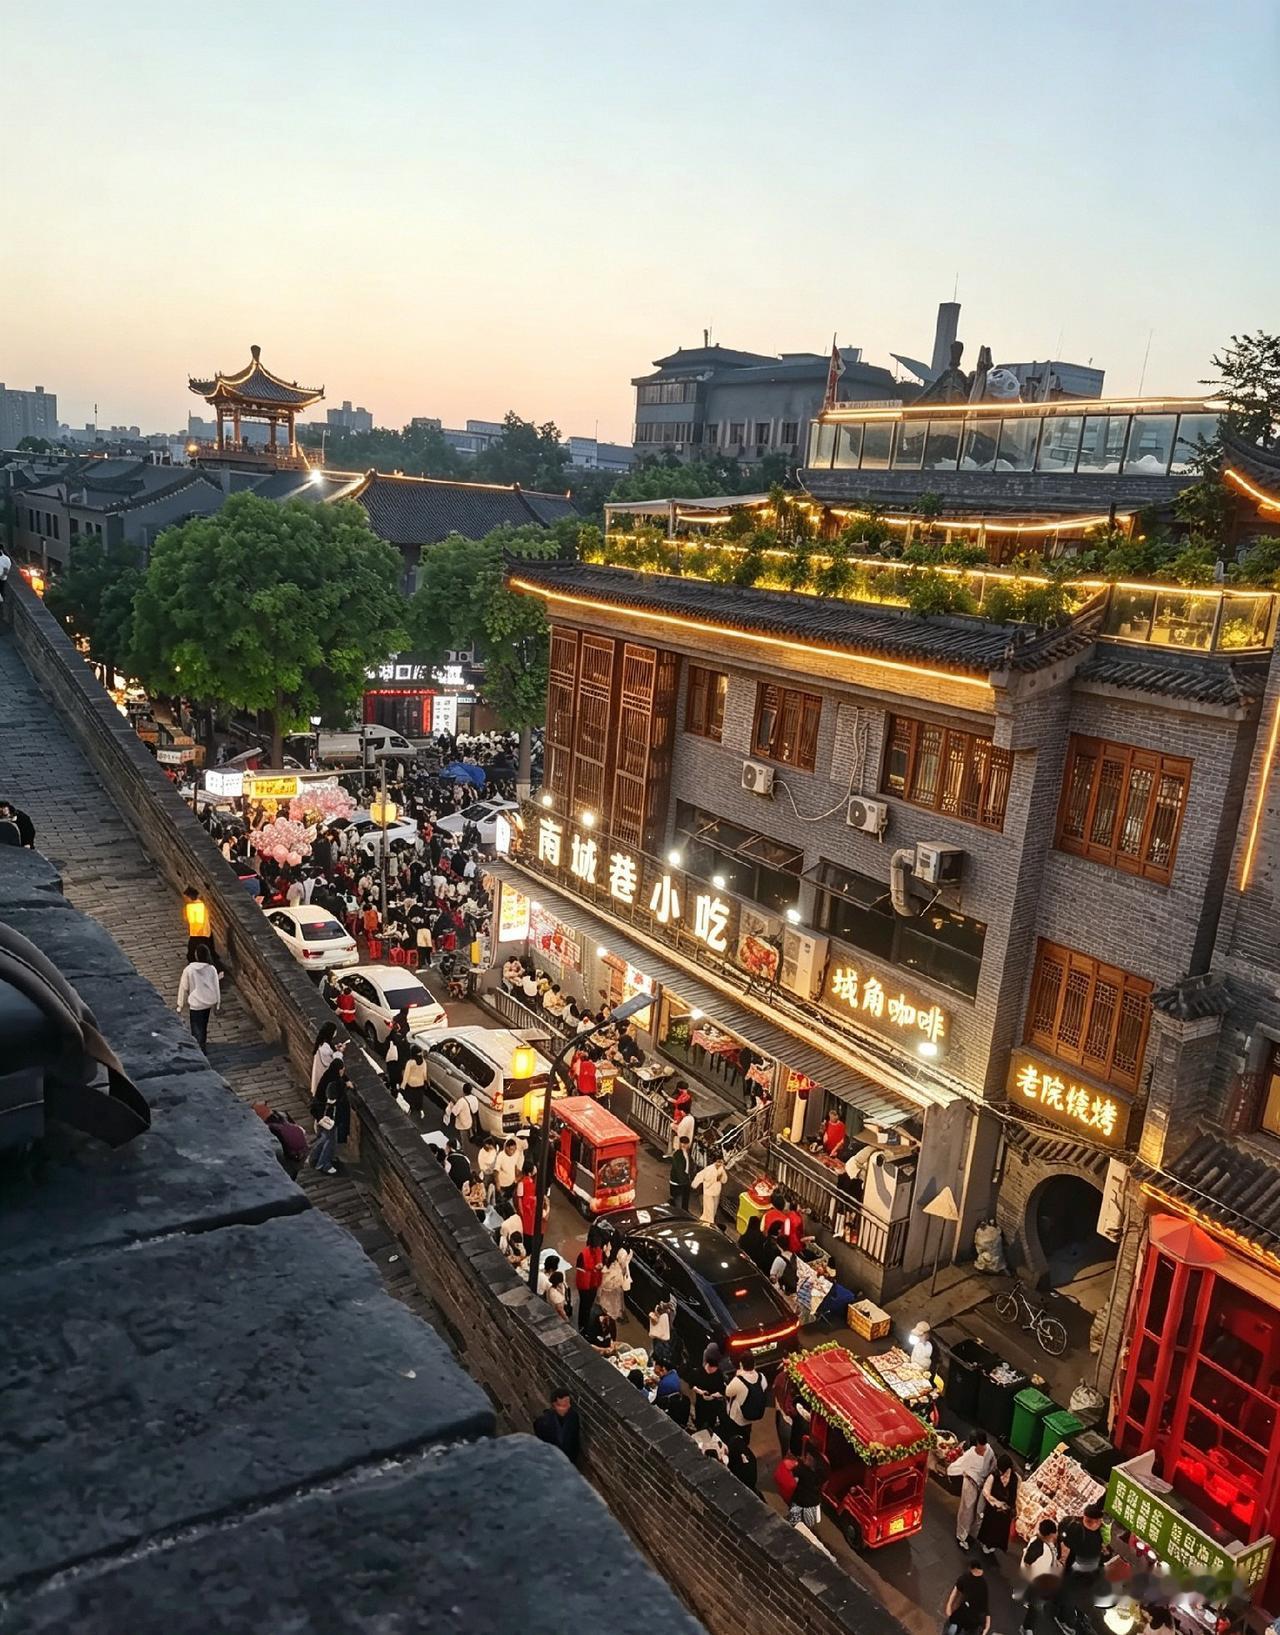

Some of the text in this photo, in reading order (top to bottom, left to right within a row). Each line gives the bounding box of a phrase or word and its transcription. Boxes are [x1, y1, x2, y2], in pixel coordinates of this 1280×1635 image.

[831, 967, 945, 1043] 城角咖啡
[1016, 1064, 1118, 1136] 老院烧烤
